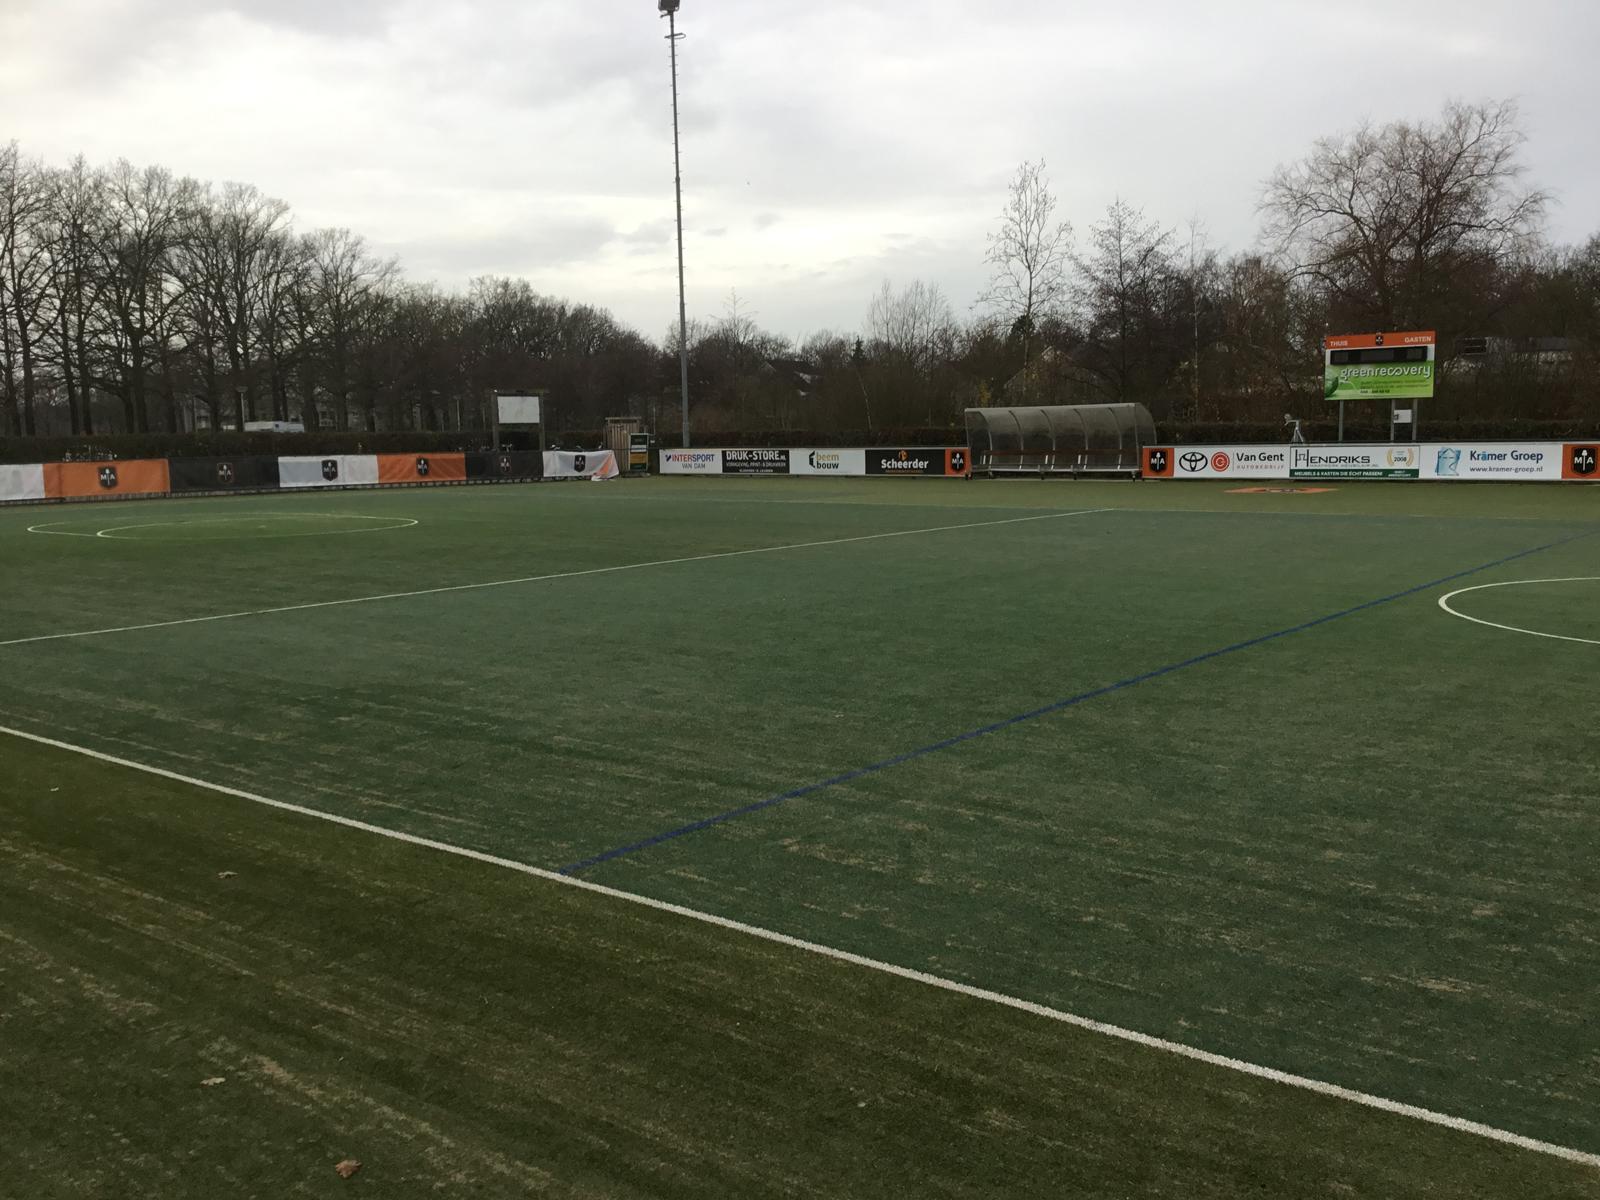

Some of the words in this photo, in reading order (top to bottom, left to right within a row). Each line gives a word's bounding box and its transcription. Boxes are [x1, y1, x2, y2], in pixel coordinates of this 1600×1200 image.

[1340, 366, 1431, 380] greenrecovery
[672, 454, 715, 462] INTERSPORT
[816, 452, 839, 461] beem
[1236, 452, 1256, 461] Van
[1258, 452, 1284, 461] Gent
[1295, 449, 1370, 467] HENDRIKS
[1470, 450, 1507, 461] Krämer
[1511, 450, 1543, 464] Groep
[816, 461, 839, 469] bouw
[881, 459, 928, 469] Scheerder
[1470, 465, 1543, 473] www.kramer-groep.nl
